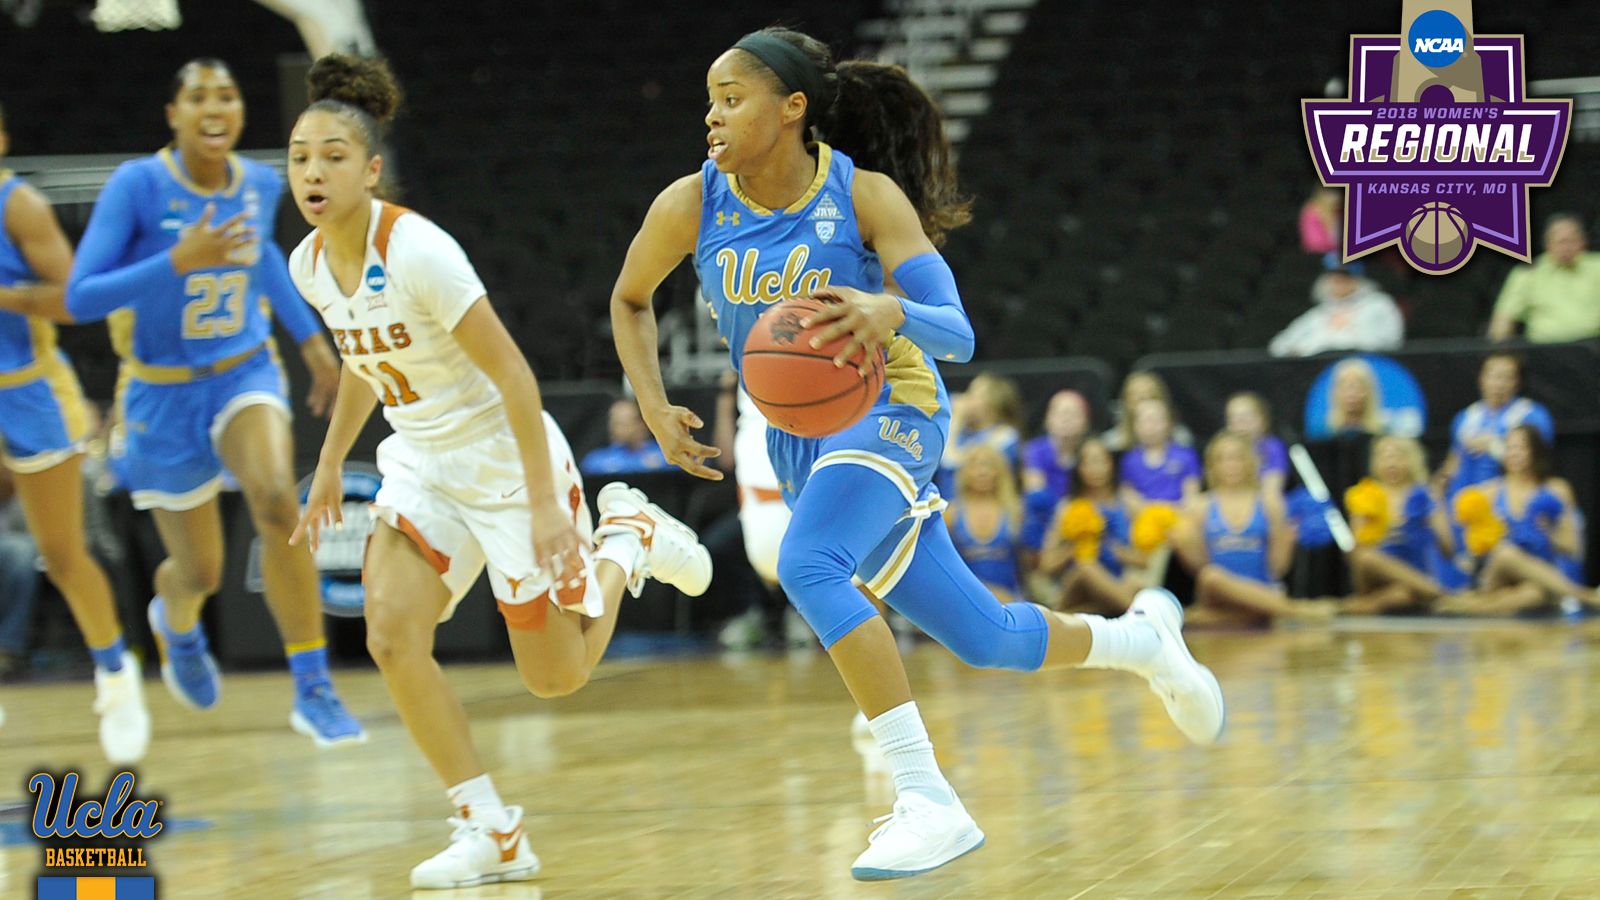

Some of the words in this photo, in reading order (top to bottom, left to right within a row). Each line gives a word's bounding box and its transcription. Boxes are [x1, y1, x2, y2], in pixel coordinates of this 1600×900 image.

[716, 243, 832, 305] Ucla
[180, 269, 248, 340] 23
[359, 361, 421, 407] 11
[878, 415, 923, 461] Ucla
